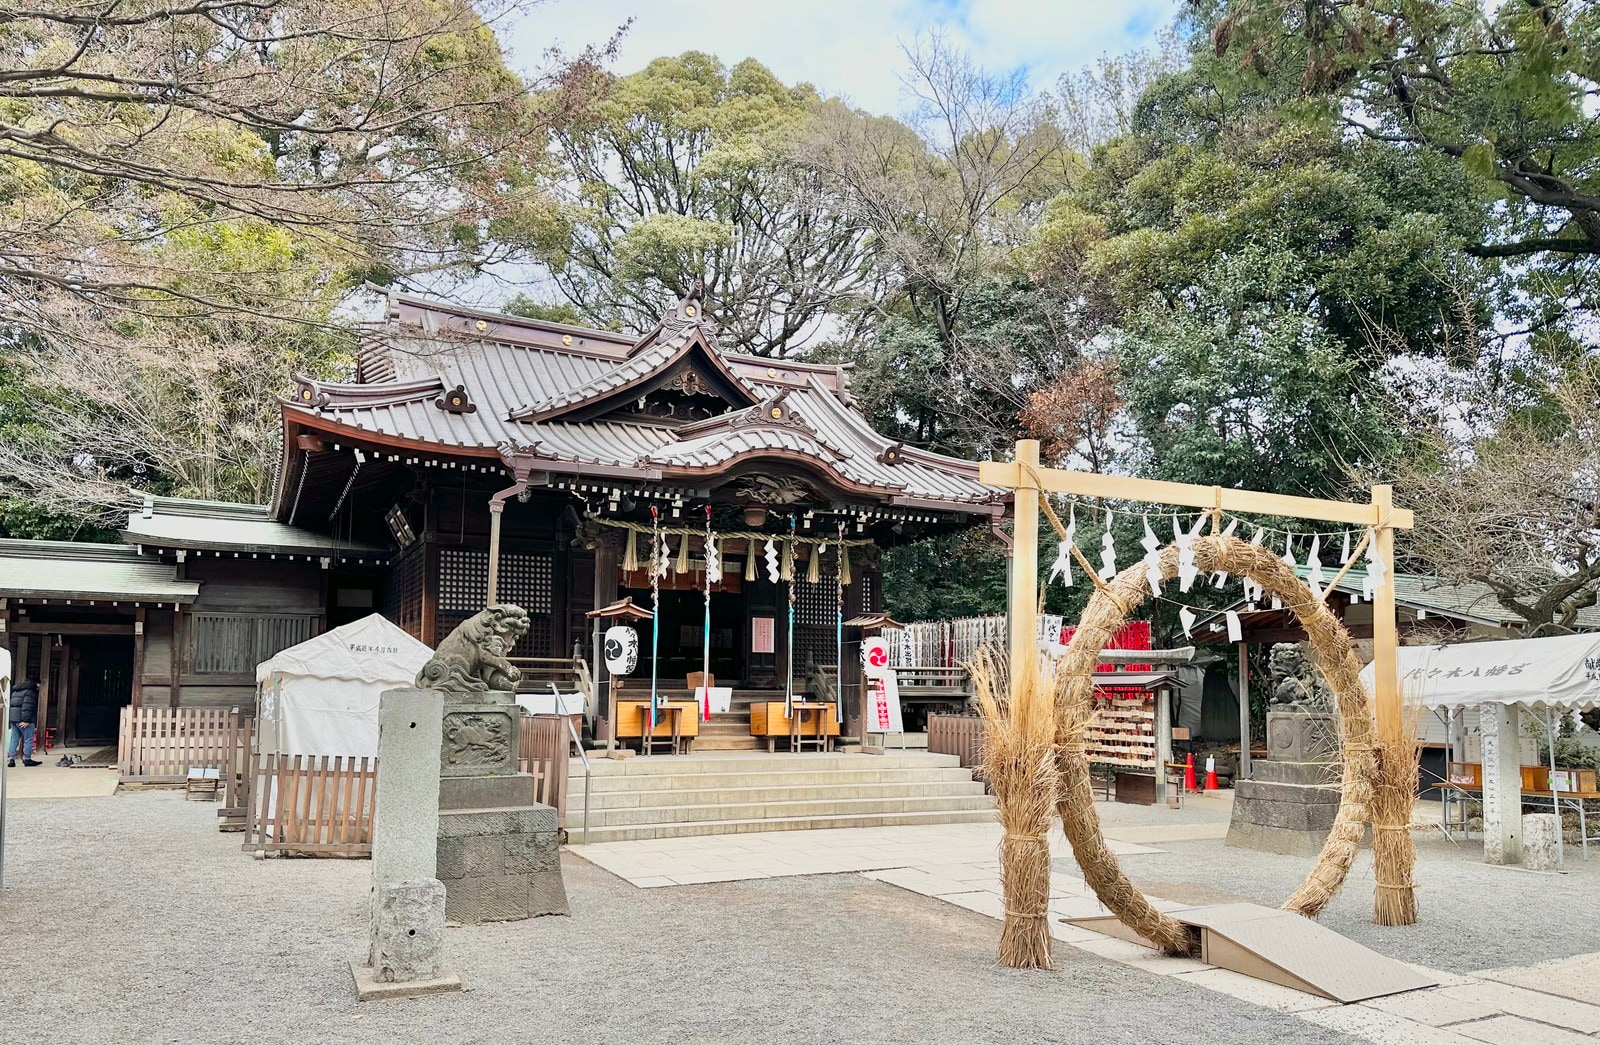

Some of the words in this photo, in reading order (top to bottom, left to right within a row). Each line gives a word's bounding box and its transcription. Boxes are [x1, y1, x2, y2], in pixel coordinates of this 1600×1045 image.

[1403, 662, 1532, 680] 代々木八幡宮
